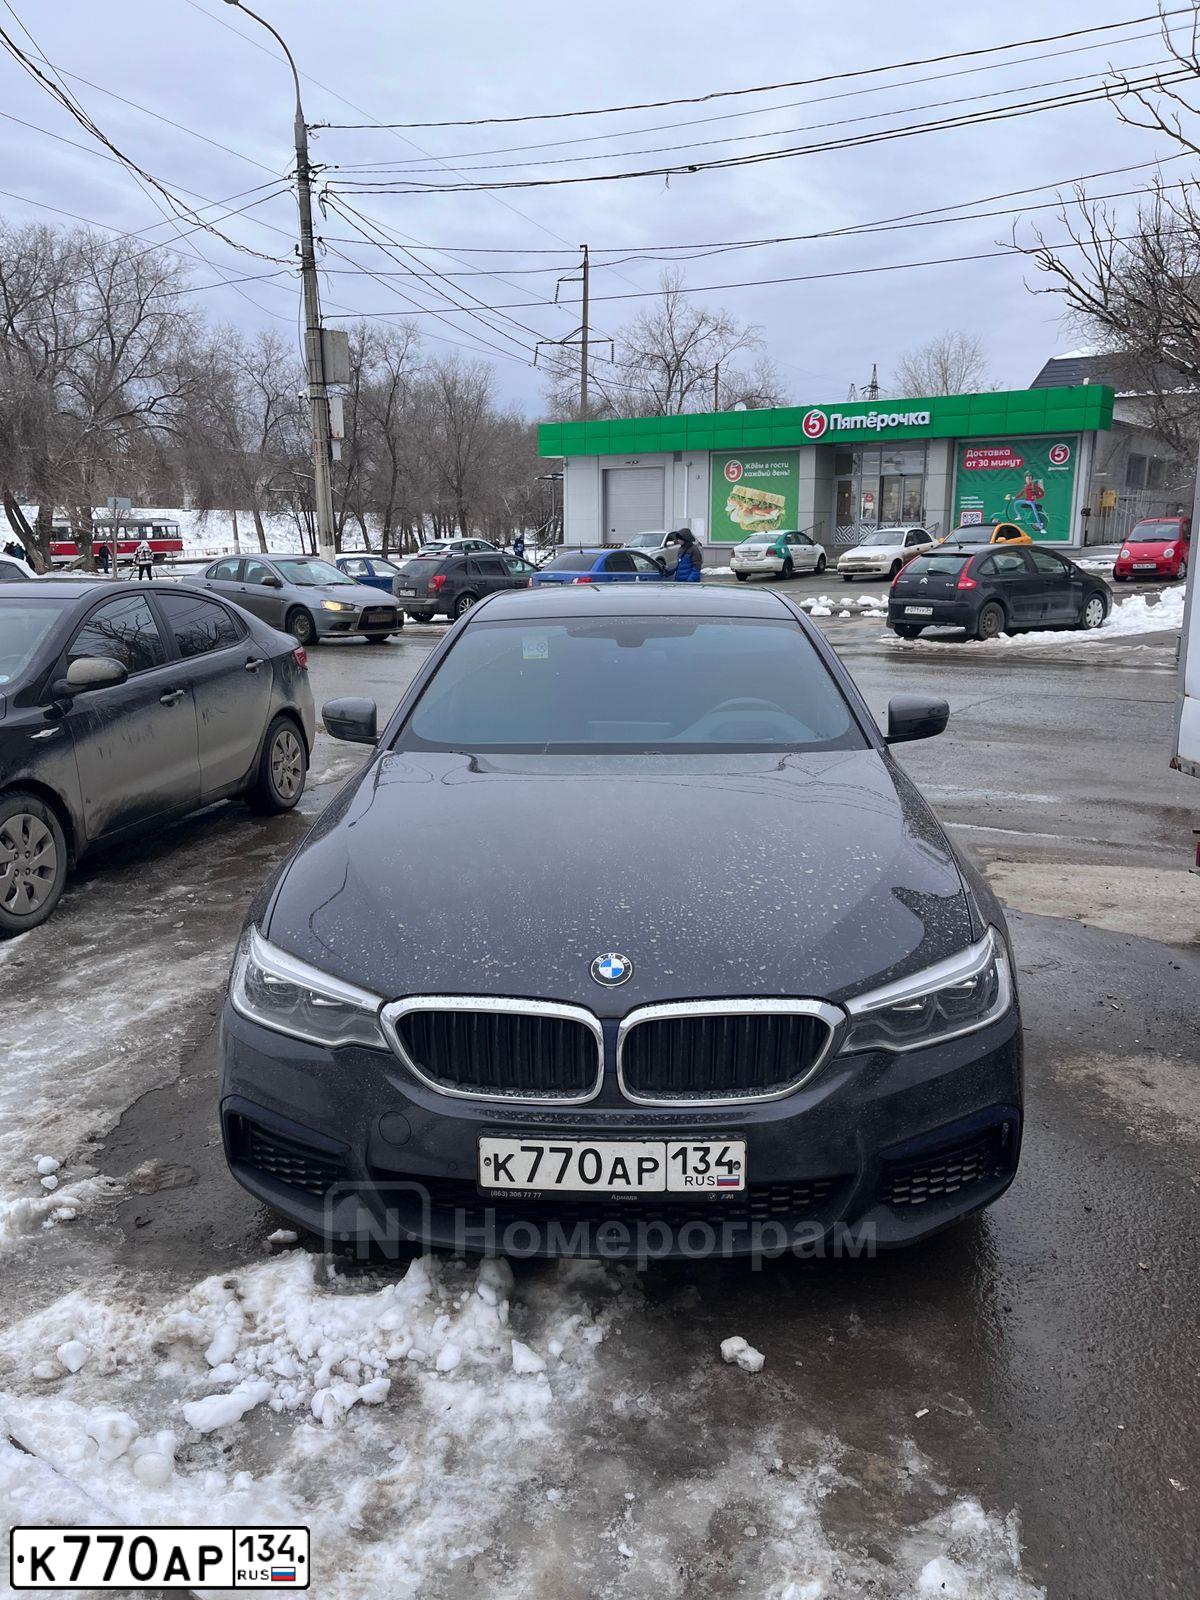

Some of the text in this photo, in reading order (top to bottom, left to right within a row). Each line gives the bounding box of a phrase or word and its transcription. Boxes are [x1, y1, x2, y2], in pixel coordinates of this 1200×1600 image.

[830, 411, 931, 432] Пятёрочка
[966, 449, 1011, 458] Доставка
[978, 459, 989, 467] 30
[990, 459, 1022, 468] минут
[493, 1146, 734, 1186] К770АР 134
[684, 1176, 715, 1186] RUS
